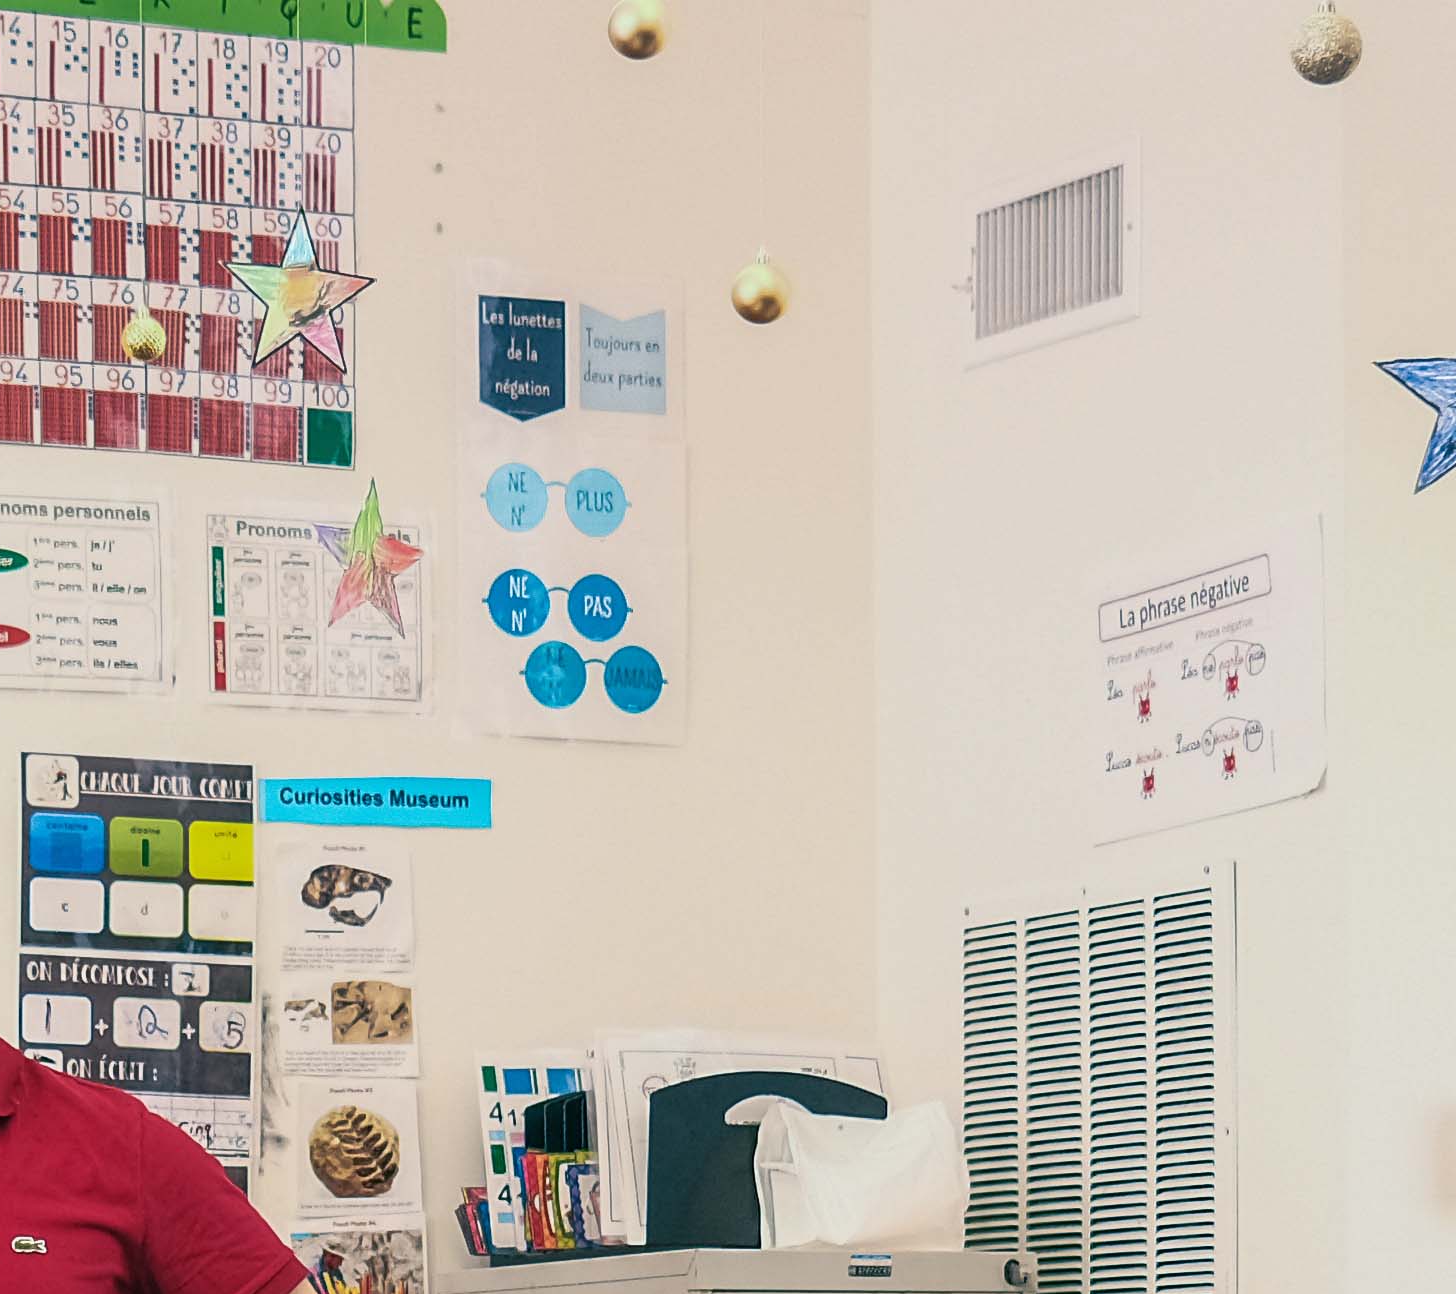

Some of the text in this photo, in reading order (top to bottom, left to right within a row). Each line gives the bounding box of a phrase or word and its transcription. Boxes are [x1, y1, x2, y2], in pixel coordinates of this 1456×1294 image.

[482, 301, 562, 328] Les lunettes
[507, 337, 537, 361] de la
[586, 327, 659, 356] Toujours en
[584, 357, 662, 390] deux parties
[495, 379, 550, 399] négation
[509, 472, 613, 513] NE PLUS
[54, 506, 150, 521] personnels
[510, 576, 612, 618] NE PAS
[1120, 573, 1249, 630] La phrase négative
[152, 775, 192, 796] JOUR
[280, 787, 469, 808] Curiosities Museum
[27, 961, 51, 981] ON
[67, 1059, 91, 1078] ON
